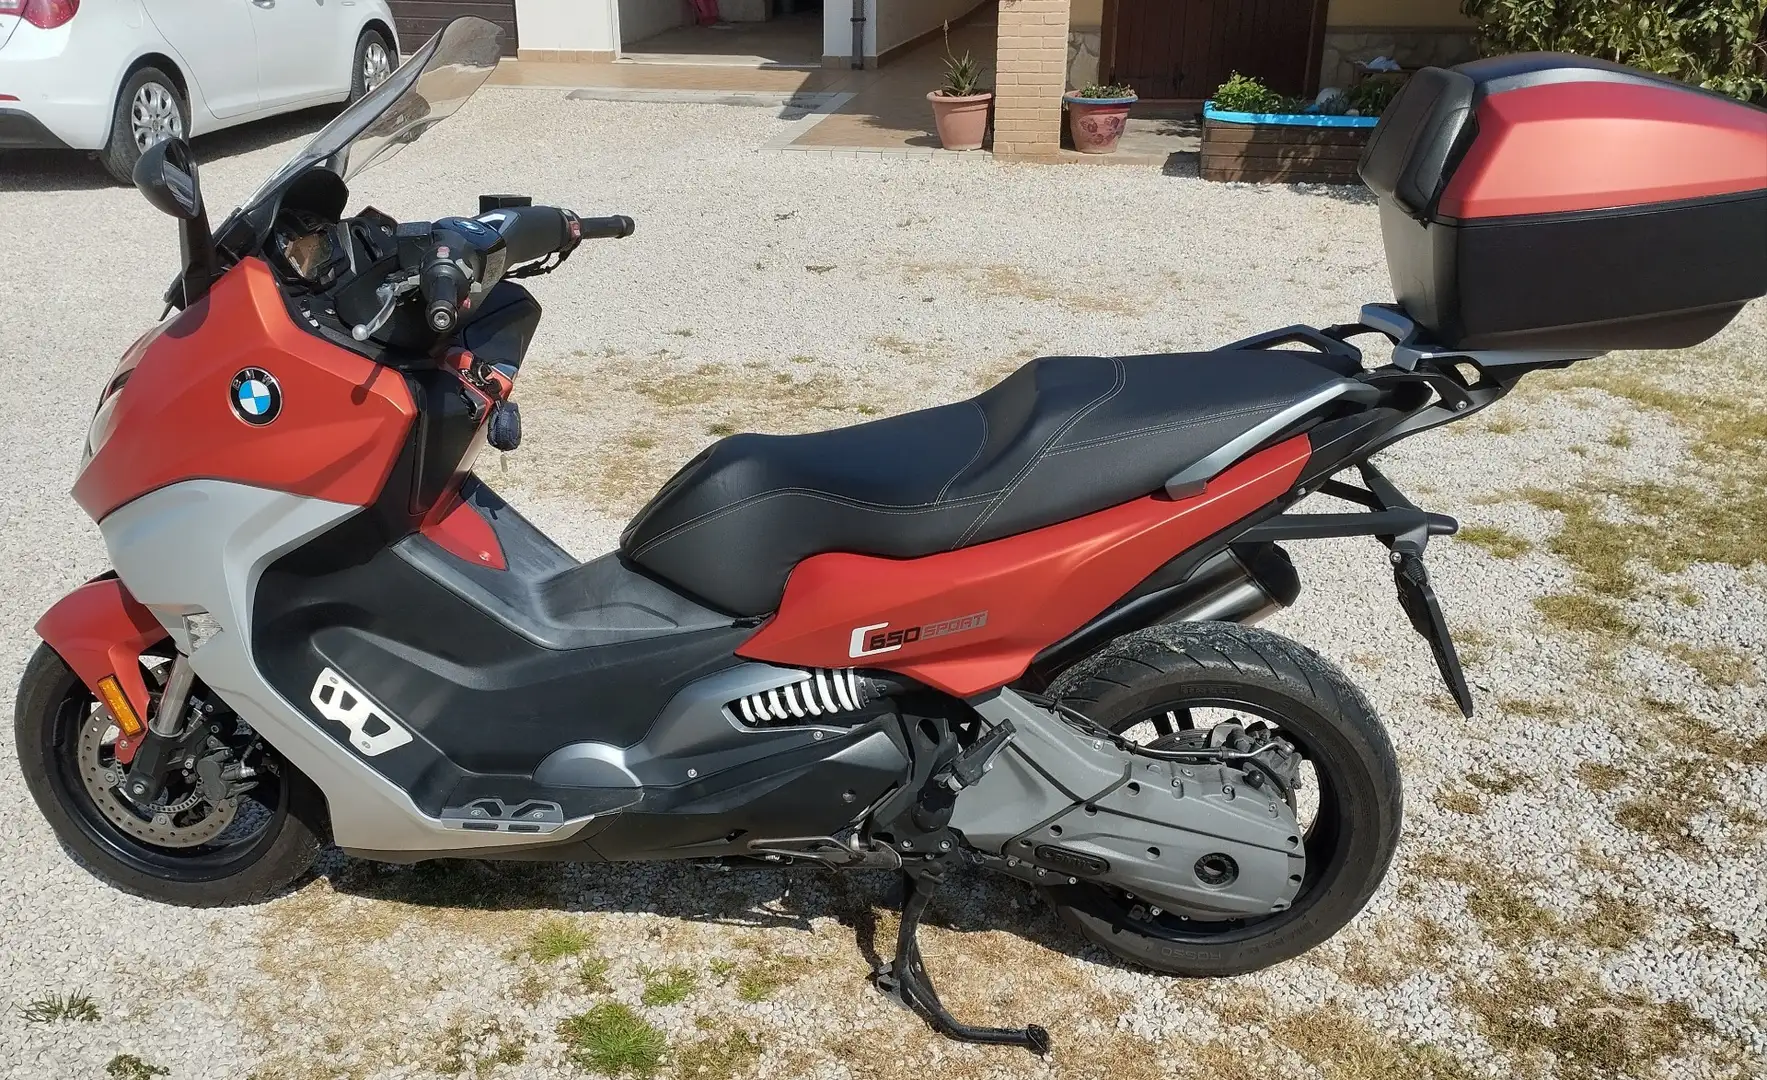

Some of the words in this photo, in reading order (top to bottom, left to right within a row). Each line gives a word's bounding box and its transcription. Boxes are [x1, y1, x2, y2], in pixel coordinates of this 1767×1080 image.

[233, 369, 273, 390] BMW
[922, 612, 988, 639] SPORT
[1161, 946, 1222, 961] ROSSO
